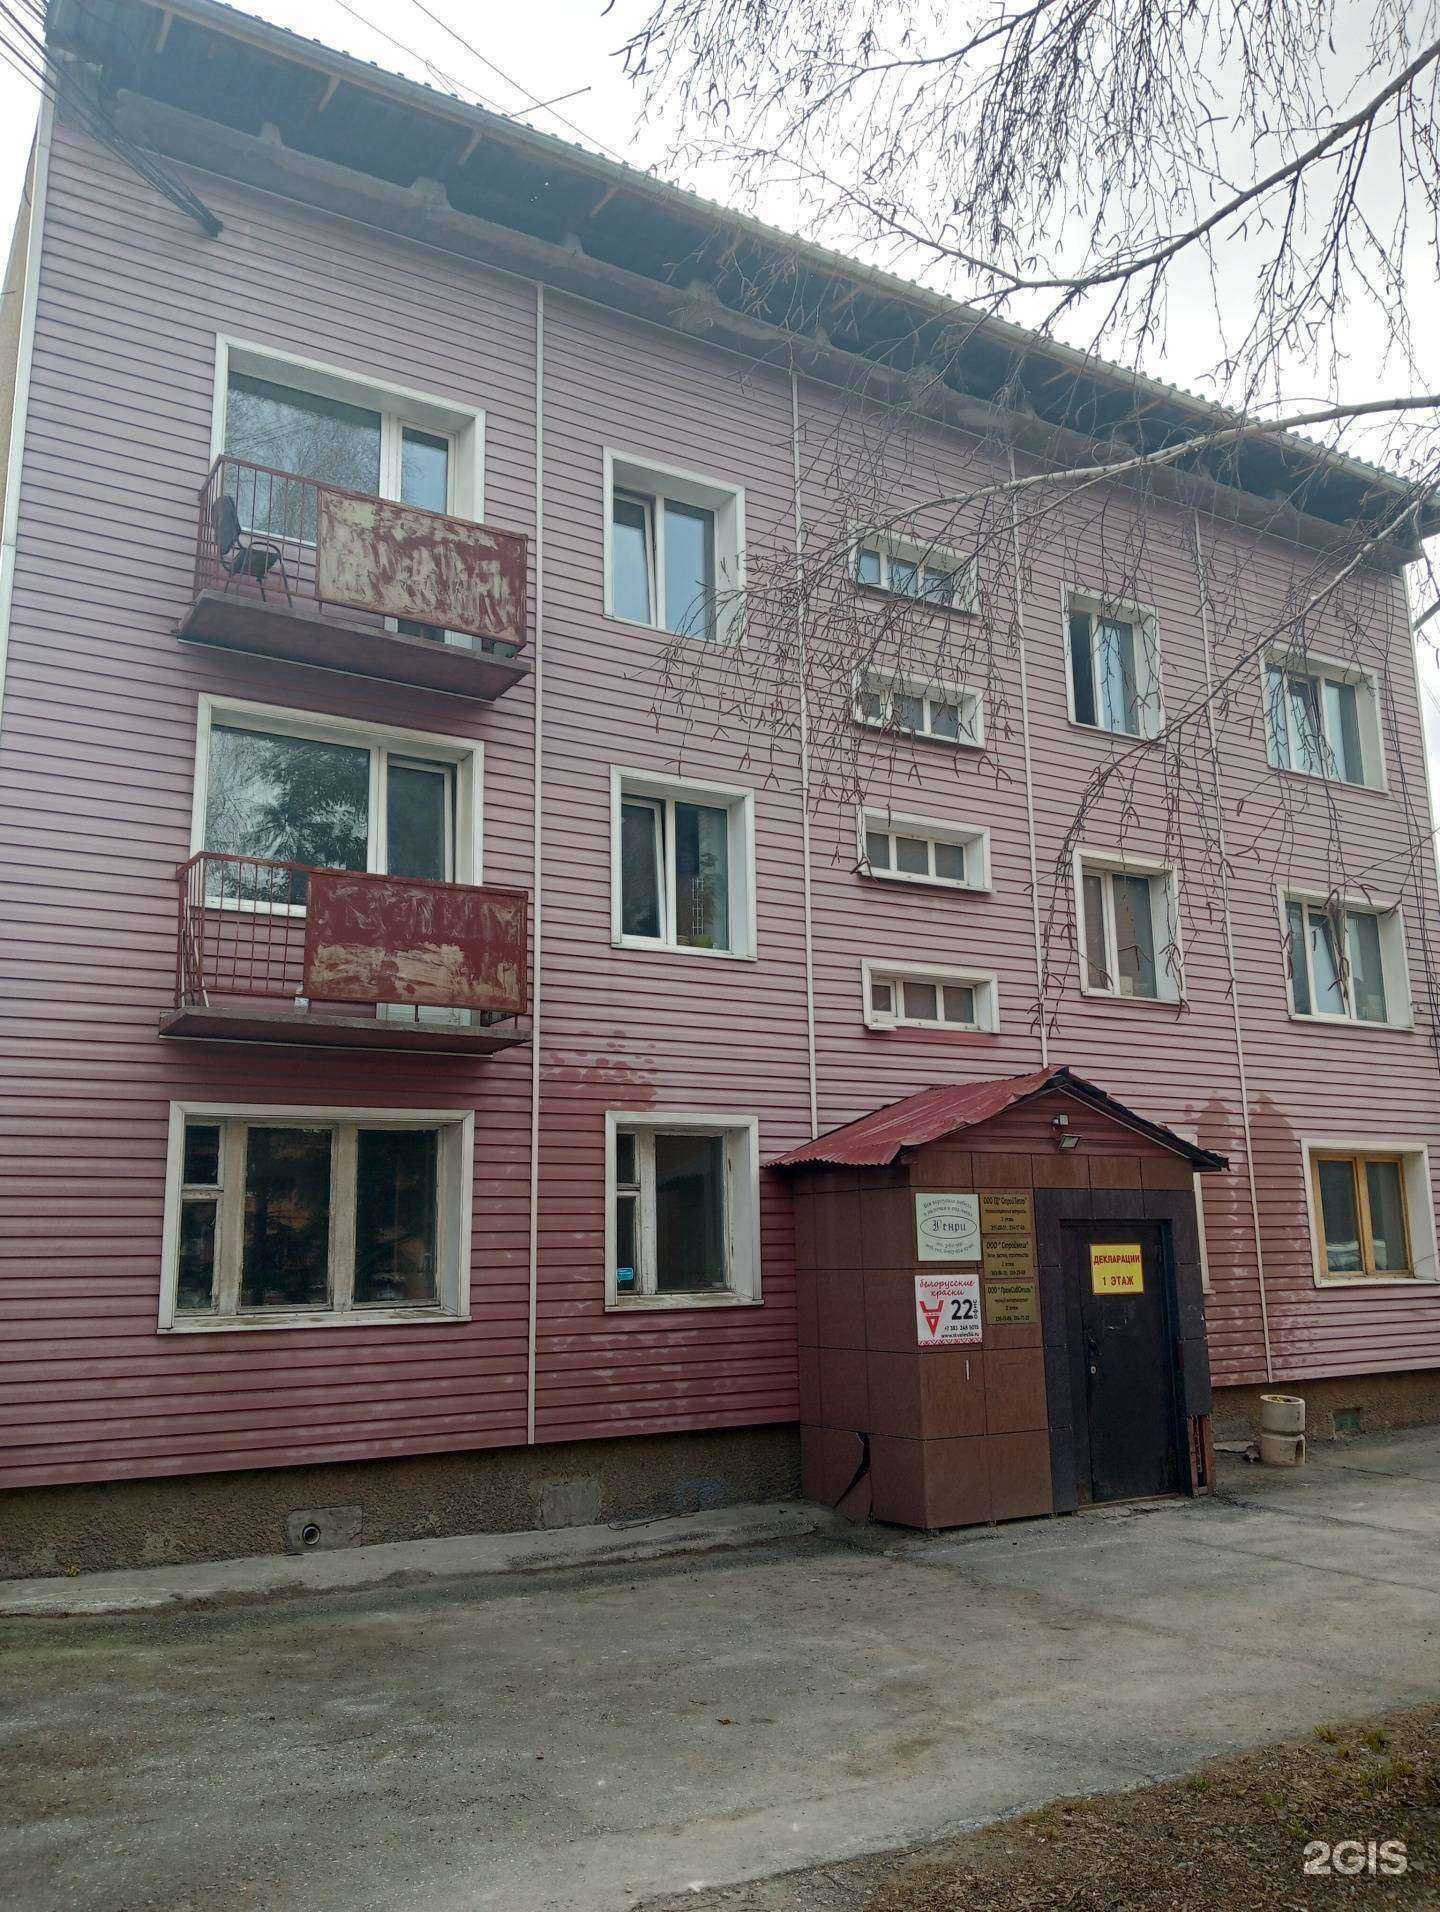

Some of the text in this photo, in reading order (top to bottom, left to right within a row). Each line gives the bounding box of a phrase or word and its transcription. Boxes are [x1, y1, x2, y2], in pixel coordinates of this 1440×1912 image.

[932, 1219, 967, 1232] Генри
[1094, 1254, 1141, 1266] ДЕКЛАРАЦИИ
[1103, 1275, 1134, 1286] 1 ЭТАЖ
[951, 1299, 974, 1321] 22
